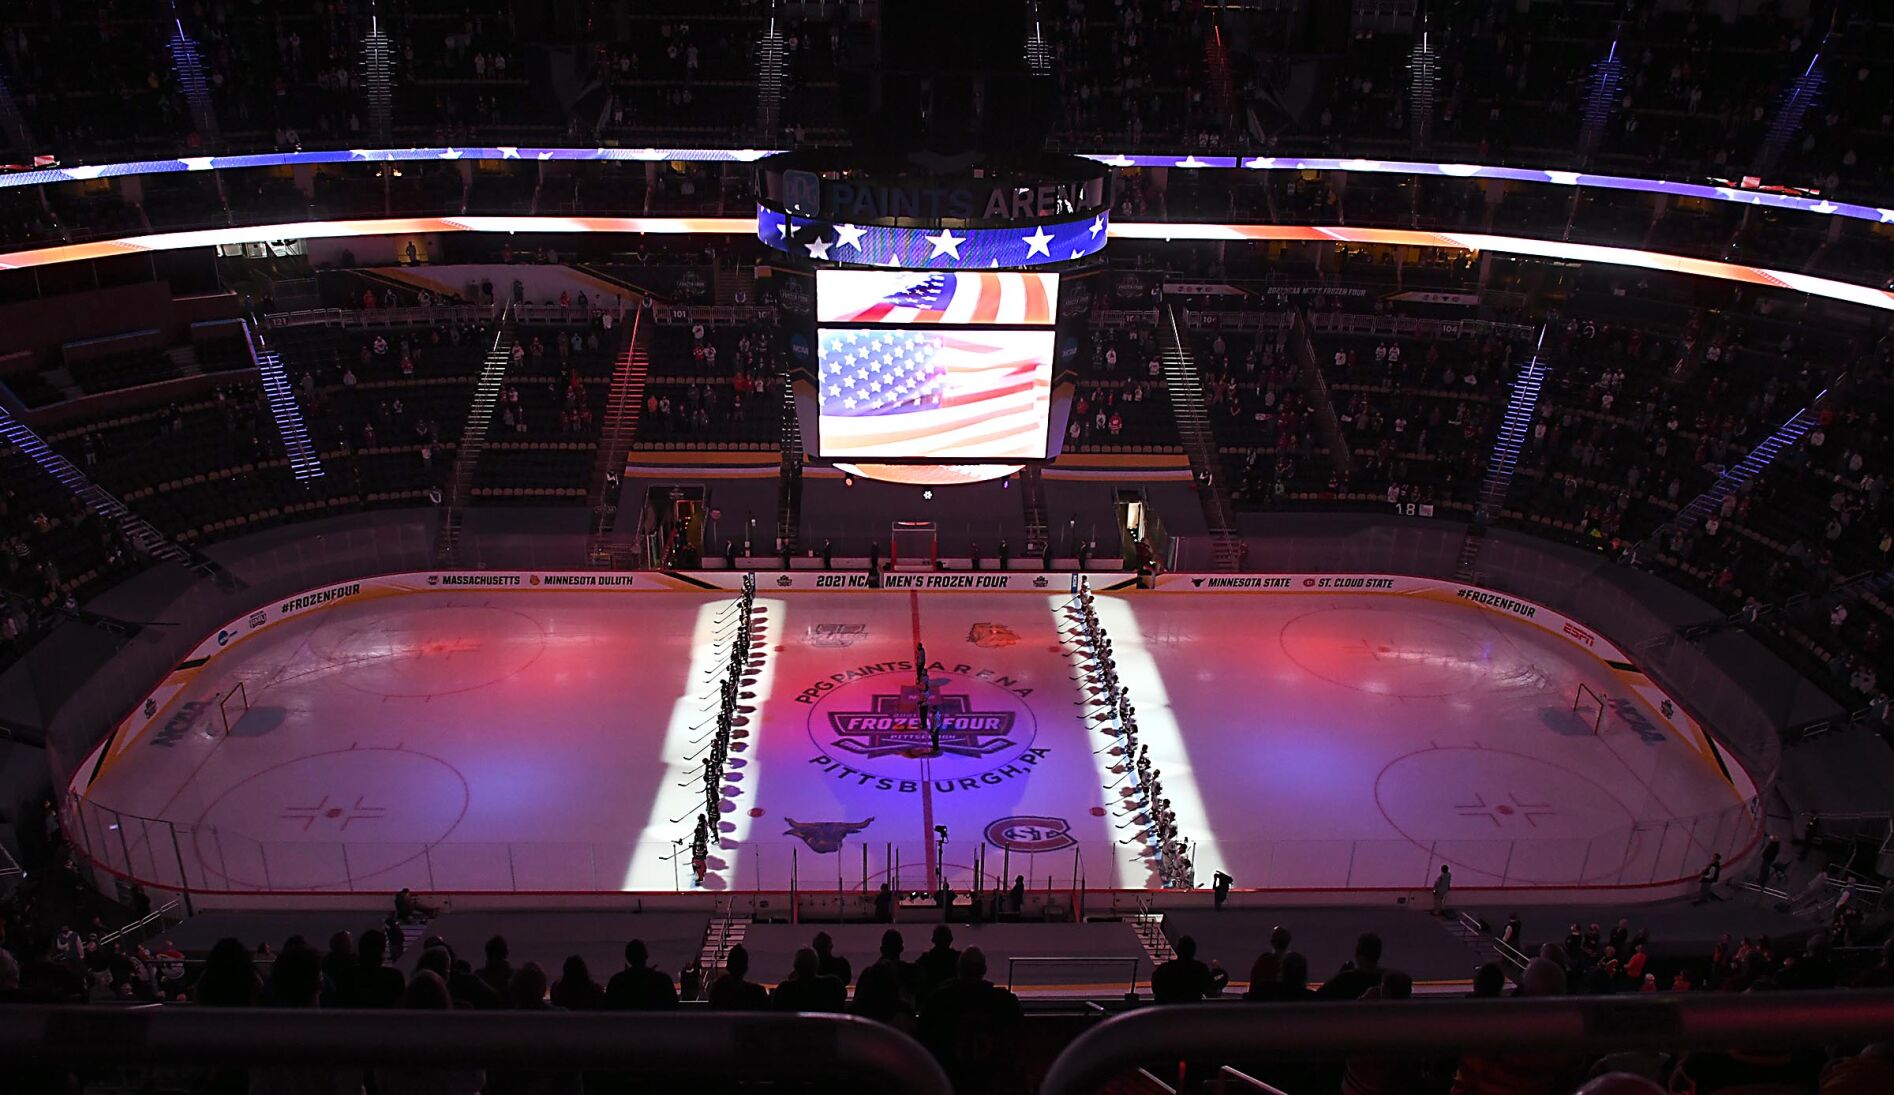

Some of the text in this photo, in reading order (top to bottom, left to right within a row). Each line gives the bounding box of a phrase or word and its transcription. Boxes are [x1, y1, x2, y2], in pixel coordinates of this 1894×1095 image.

[832, 182, 973, 219] PAINTS
[982, 178, 1090, 219] ARENA
[442, 576, 521, 585] MASSACHUSETTS
[544, 576, 596, 585] MINNESOTA
[598, 576, 633, 585] DULUTH
[816, 575, 847, 587] 2021
[885, 575, 923, 587] MEN'S
[926, 576, 972, 588] FROZEN
[975, 576, 1008, 588] FOUR
[1208, 578, 1291, 588] MINNESOTA STATE
[1317, 578, 1394, 589] ST. CLOUD STATE
[282, 584, 360, 614] #FROZENFOUR
[1457, 589, 1536, 618] #FROZENFOUR
[1563, 623, 1595, 647] ESPN
[795, 660, 1034, 704] PPG PAINTS ARENA
[941, 717, 1000, 730] FOUR
[1029, 748, 1052, 766] PA
